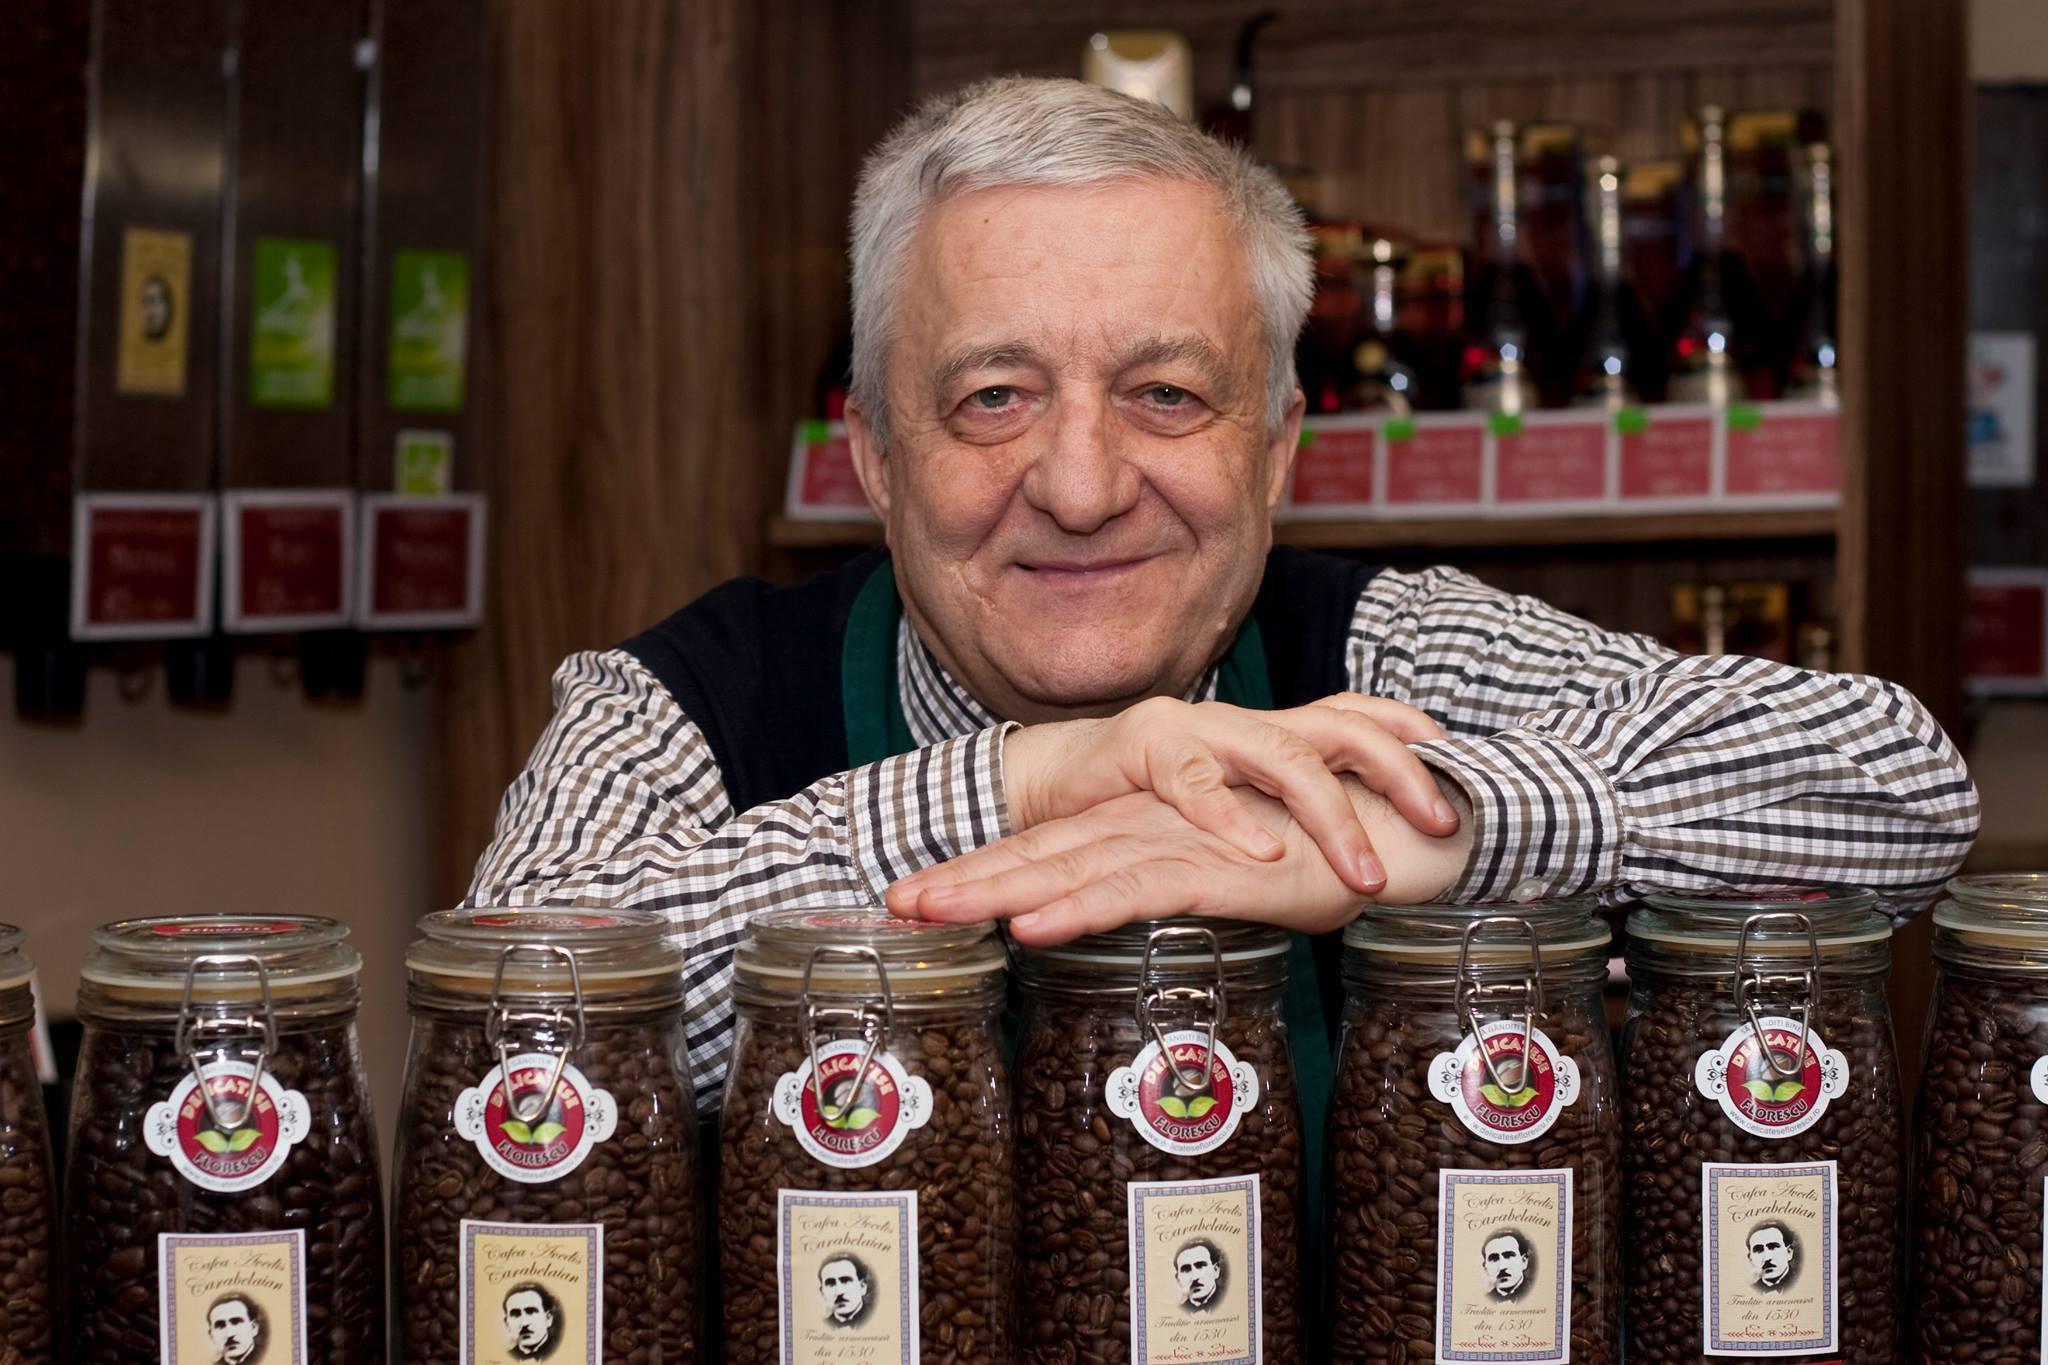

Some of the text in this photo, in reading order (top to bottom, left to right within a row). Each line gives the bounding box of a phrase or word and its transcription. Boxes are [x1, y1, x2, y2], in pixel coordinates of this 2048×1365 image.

[1475, 1102, 1541, 1128] FLORESCU
[1741, 1099, 1808, 1123] FLORESCU
[1153, 1114, 1221, 1139] FLORESCU
[811, 1123, 882, 1152] FLORESCU
[192, 1146, 267, 1174] FLORESCU
[496, 1139, 569, 1166] FLORESCU
[1463, 1188, 1554, 1210] Cafea Avedis
[1725, 1181, 1818, 1202] Cafea Avedis
[798, 1214, 840, 1233] Cafea
[1152, 1204, 1194, 1222] Cafea
[183, 1255, 230, 1273] Cafea
[482, 1244, 527, 1264] Cafea
[1474, 1318, 1533, 1331] din 1530
[1741, 1309, 1801, 1321] din 1530
[1193, 1328, 1228, 1342] 1530
